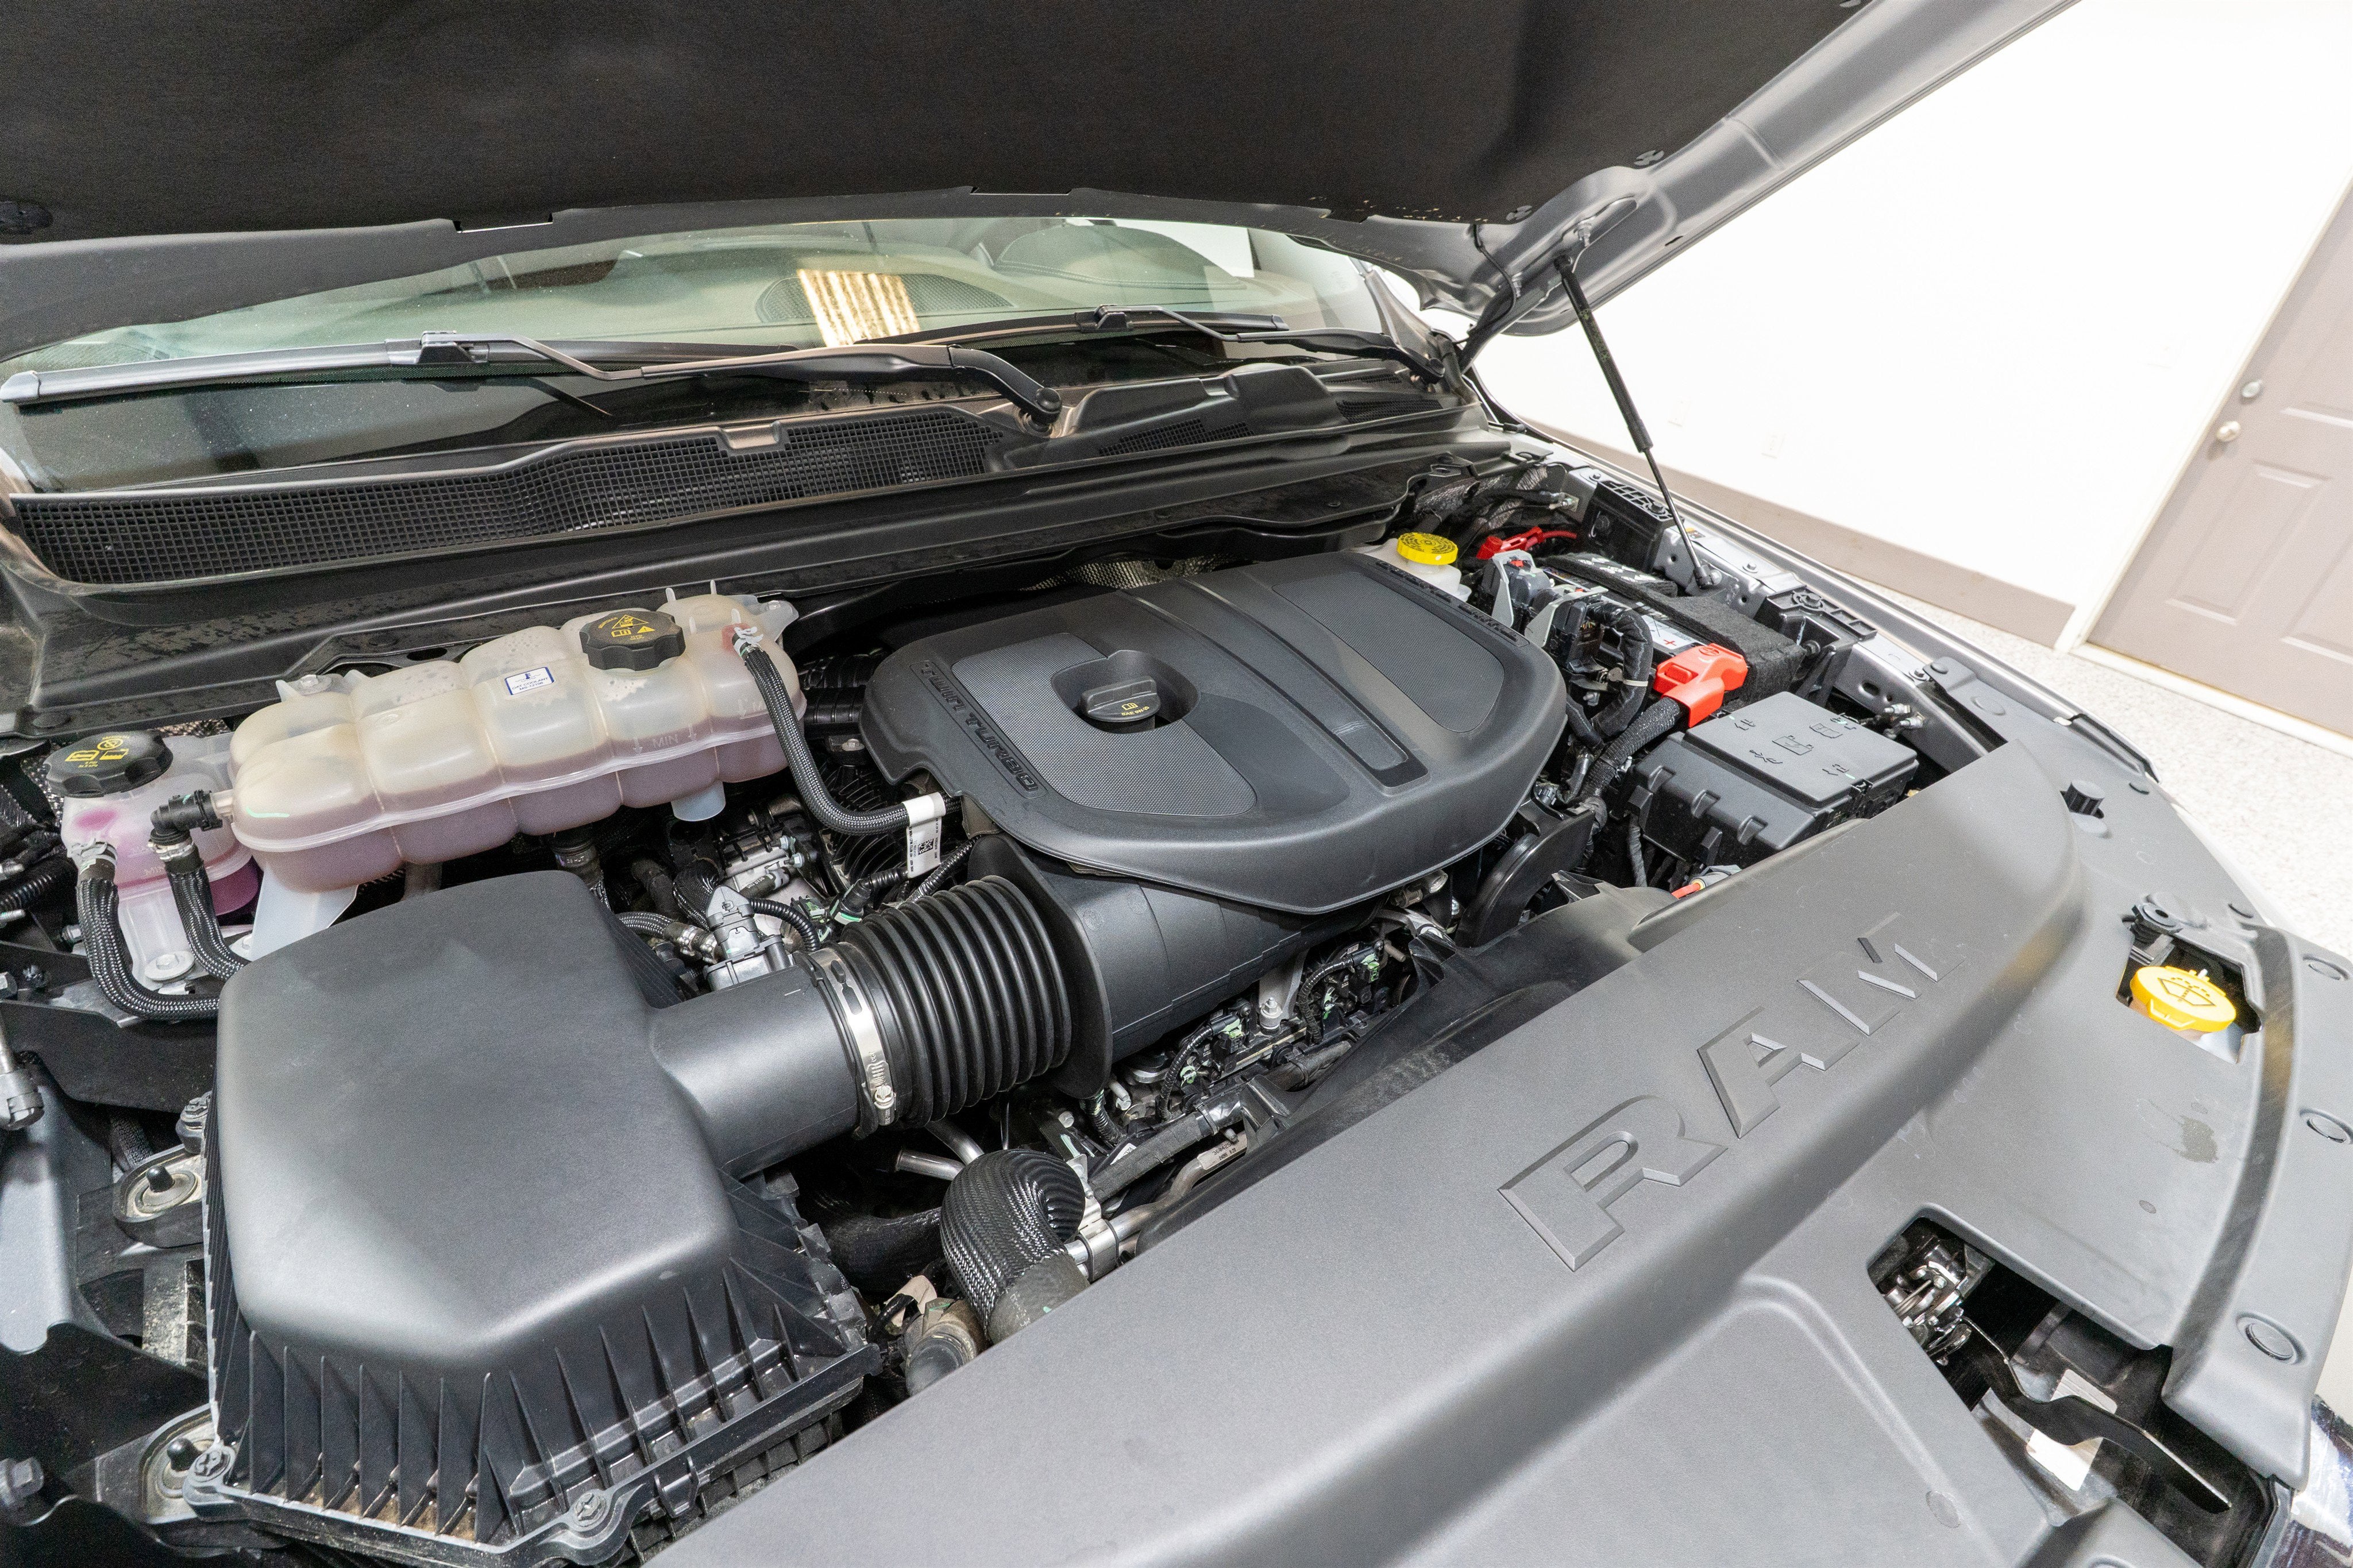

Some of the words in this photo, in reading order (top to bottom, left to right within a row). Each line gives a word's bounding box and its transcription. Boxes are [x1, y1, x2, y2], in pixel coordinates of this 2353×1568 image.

[523, 677, 548, 686] COOLANT
[652, 733, 678, 748] MIN
[965, 713, 1039, 791] TURBO
[1496, 912, 1966, 1272] RAM
